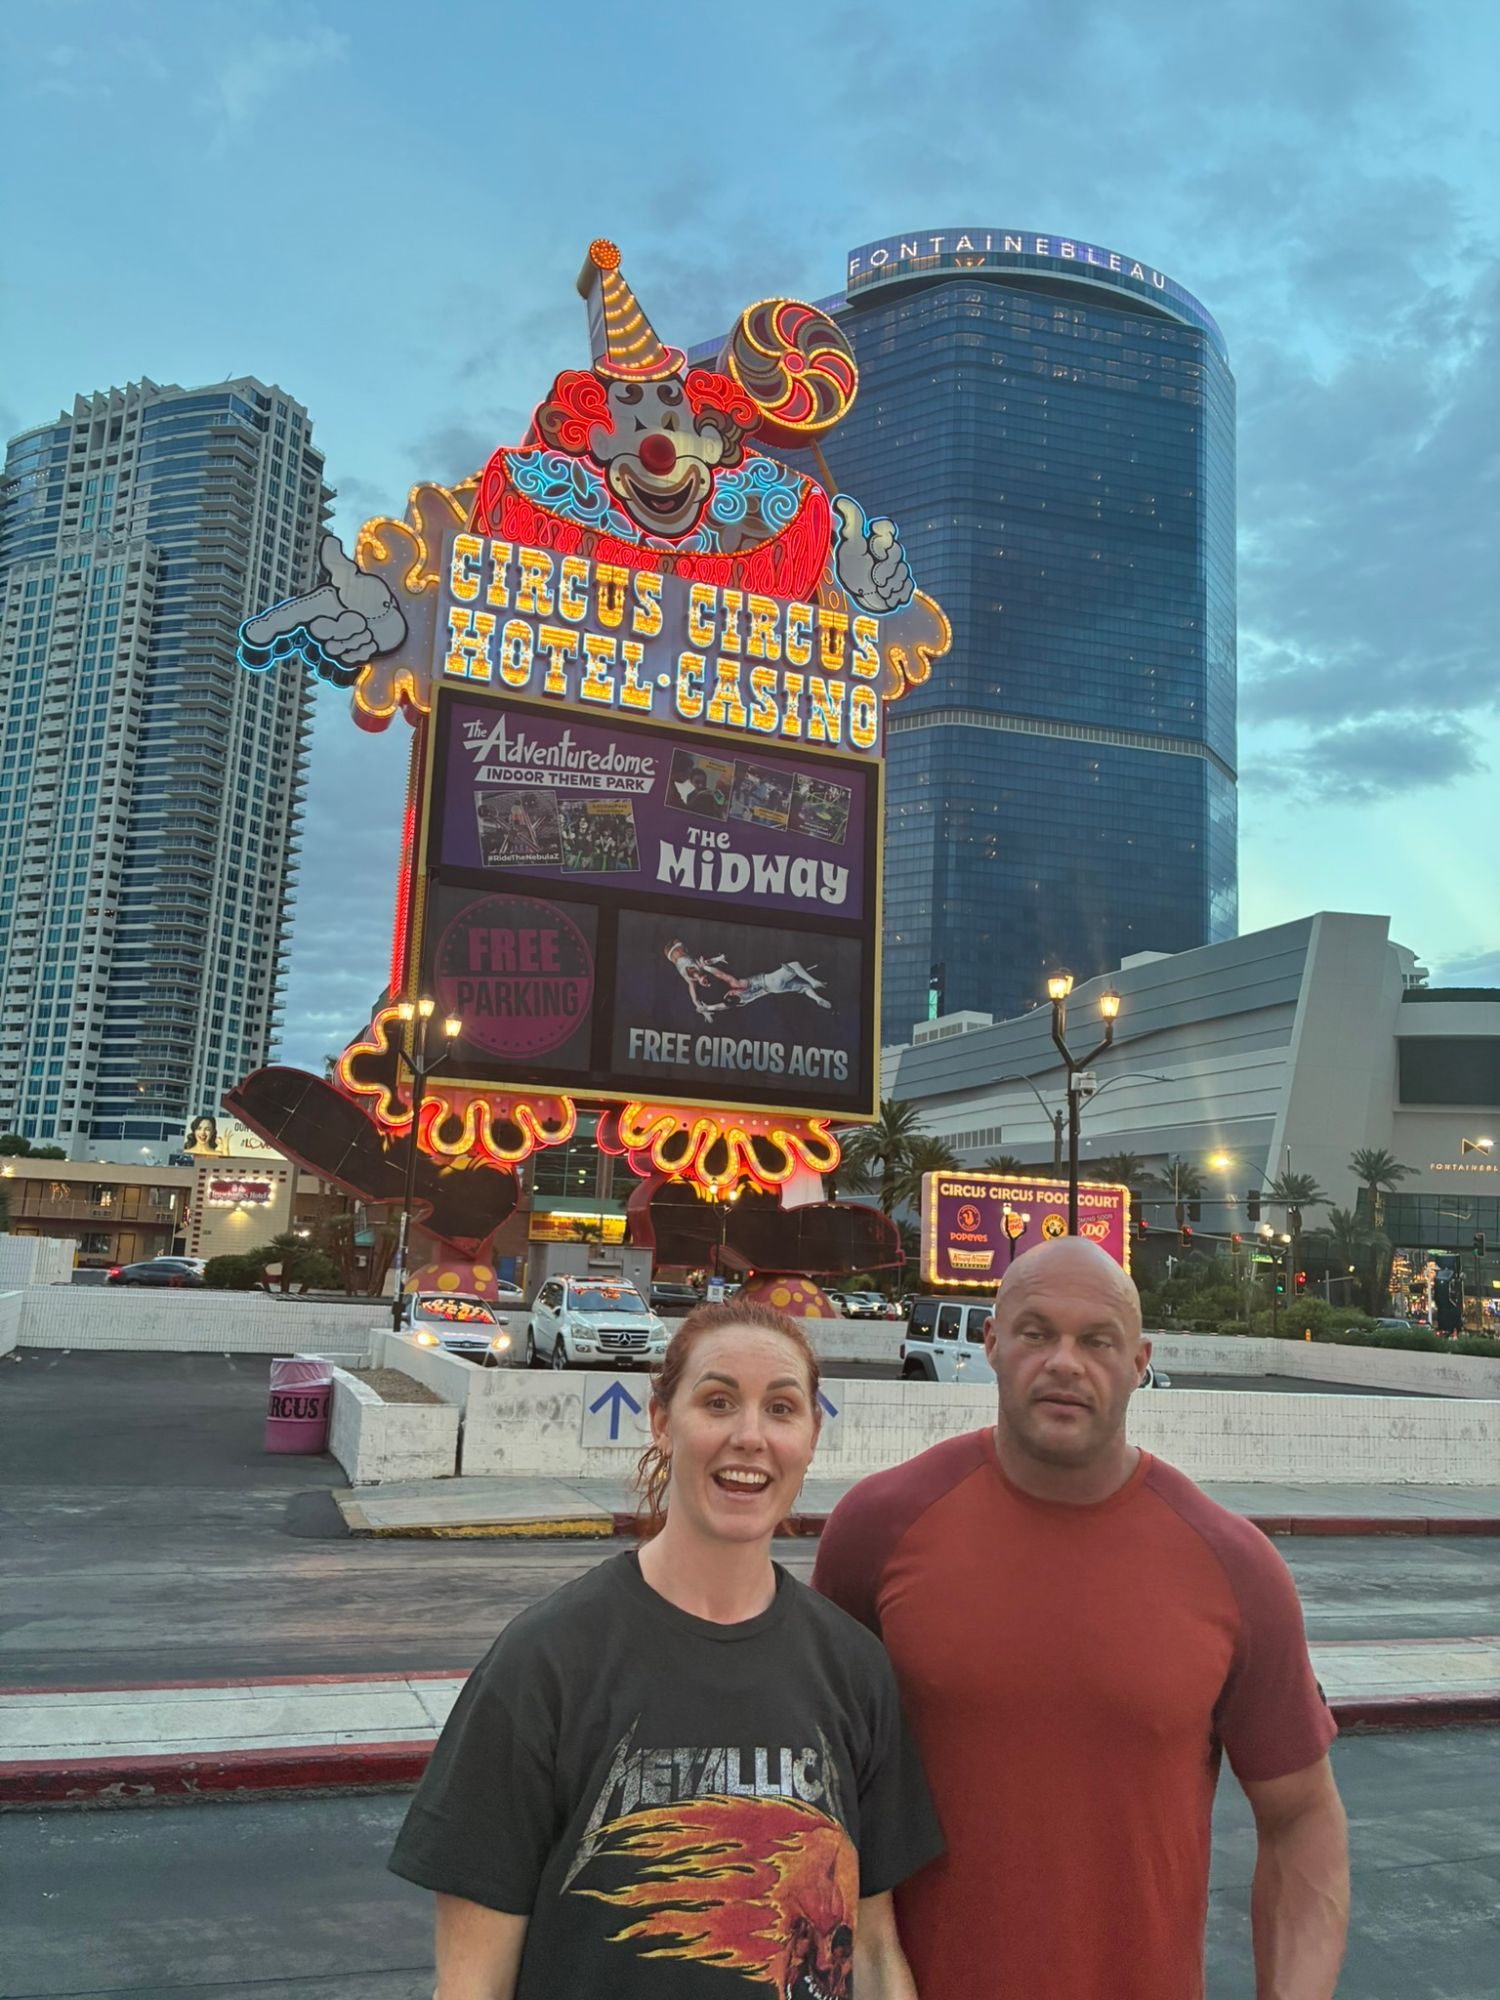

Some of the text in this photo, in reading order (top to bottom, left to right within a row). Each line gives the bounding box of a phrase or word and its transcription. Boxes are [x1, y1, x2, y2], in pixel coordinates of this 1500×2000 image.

[850, 236, 1165, 289] FONTAINEBLEAU
[450, 533, 880, 680] CIRCUS CIRCUS
[463, 719, 487, 738] The
[463, 713, 656, 775] Adventuredome
[487, 768, 646, 791] INDOOR THEME PARK
[467, 927, 560, 972] FREE
[456, 979, 579, 1017] PARKING
[628, 1028, 848, 1081] FREE CIRCUS ACTS
[940, 1183, 1119, 1209] CIRCUS CIRCUS FOOD COURT
[1087, 1223, 1105, 1238] DQ
